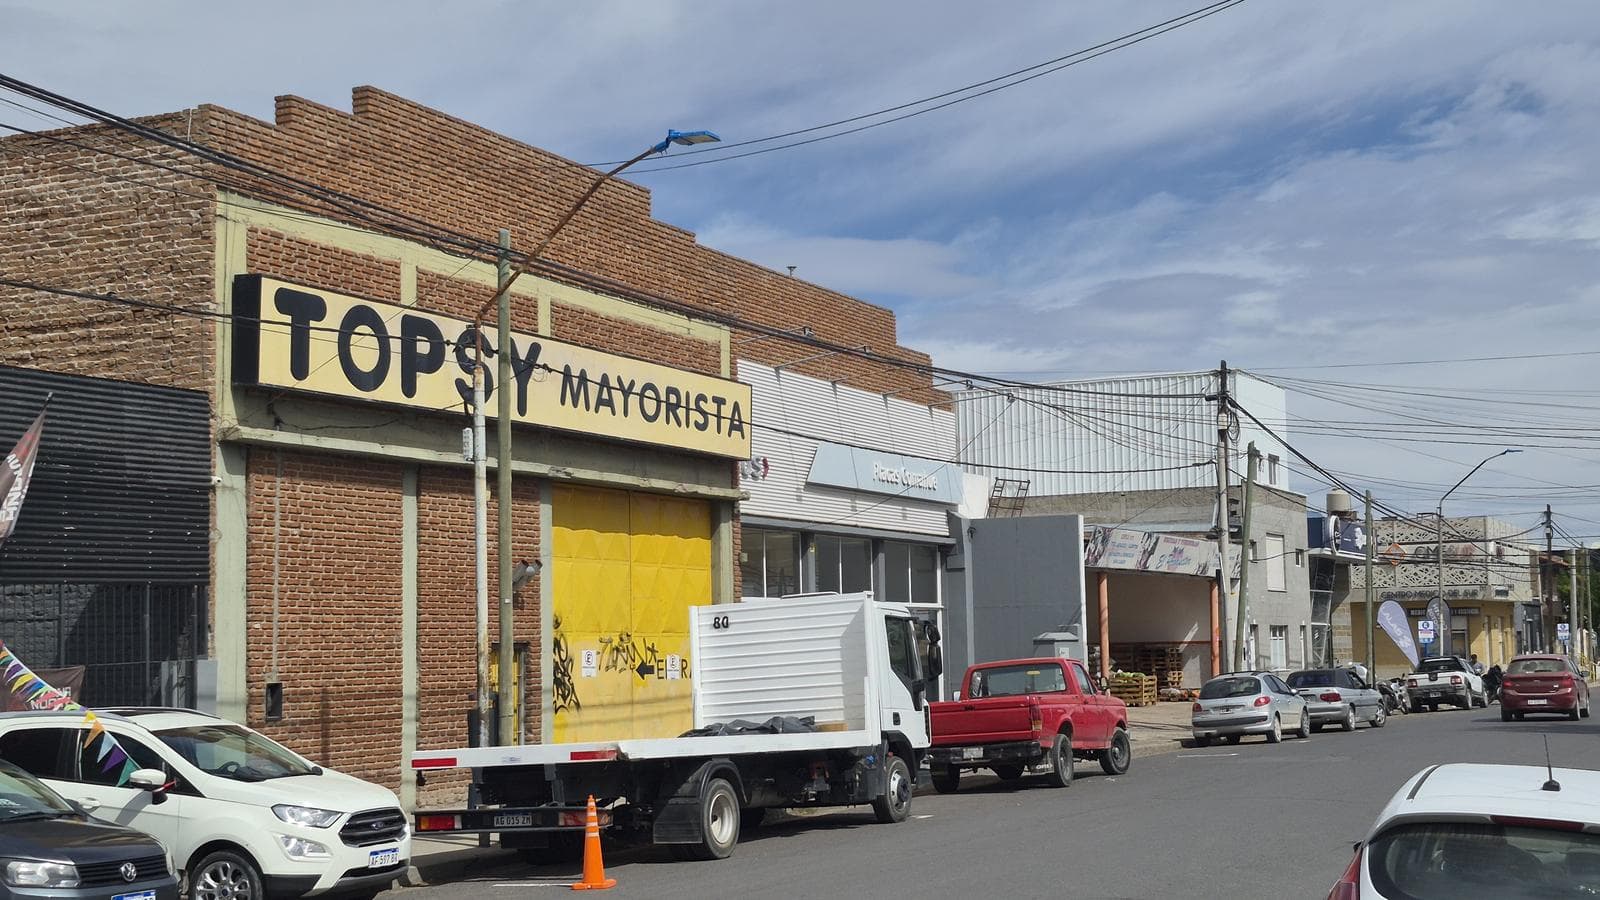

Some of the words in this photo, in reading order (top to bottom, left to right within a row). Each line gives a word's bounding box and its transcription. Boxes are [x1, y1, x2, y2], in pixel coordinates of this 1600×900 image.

[273, 287, 542, 417] TOPSY
[560, 362, 746, 440] MAYORISTA
[1380, 590, 1413, 599] CENTRO
[1448, 589, 1462, 597] DEL
[1463, 589, 1479, 597] SUR
